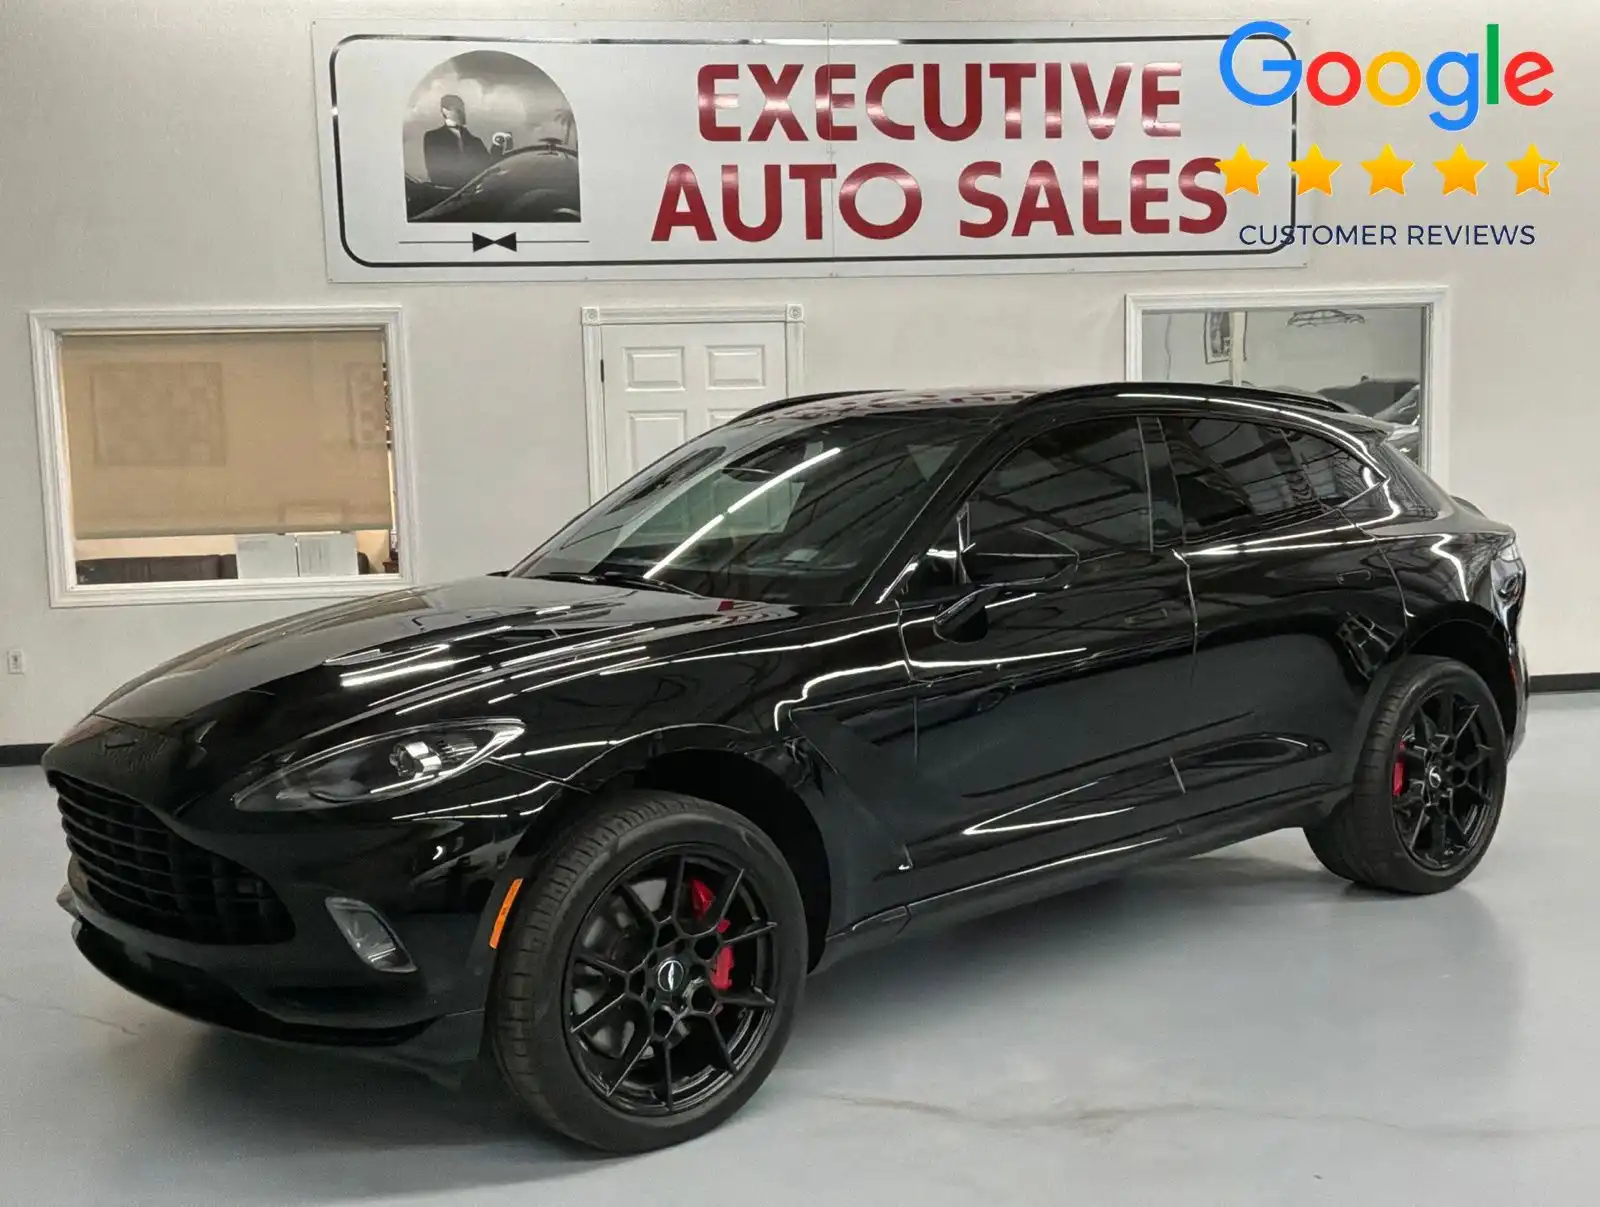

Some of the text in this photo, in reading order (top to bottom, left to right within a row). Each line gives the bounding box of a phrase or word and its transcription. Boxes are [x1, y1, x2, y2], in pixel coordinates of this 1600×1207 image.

[697, 62, 1182, 142] EXECUTIVE
[651, 156, 1229, 243] AUTO SALES
